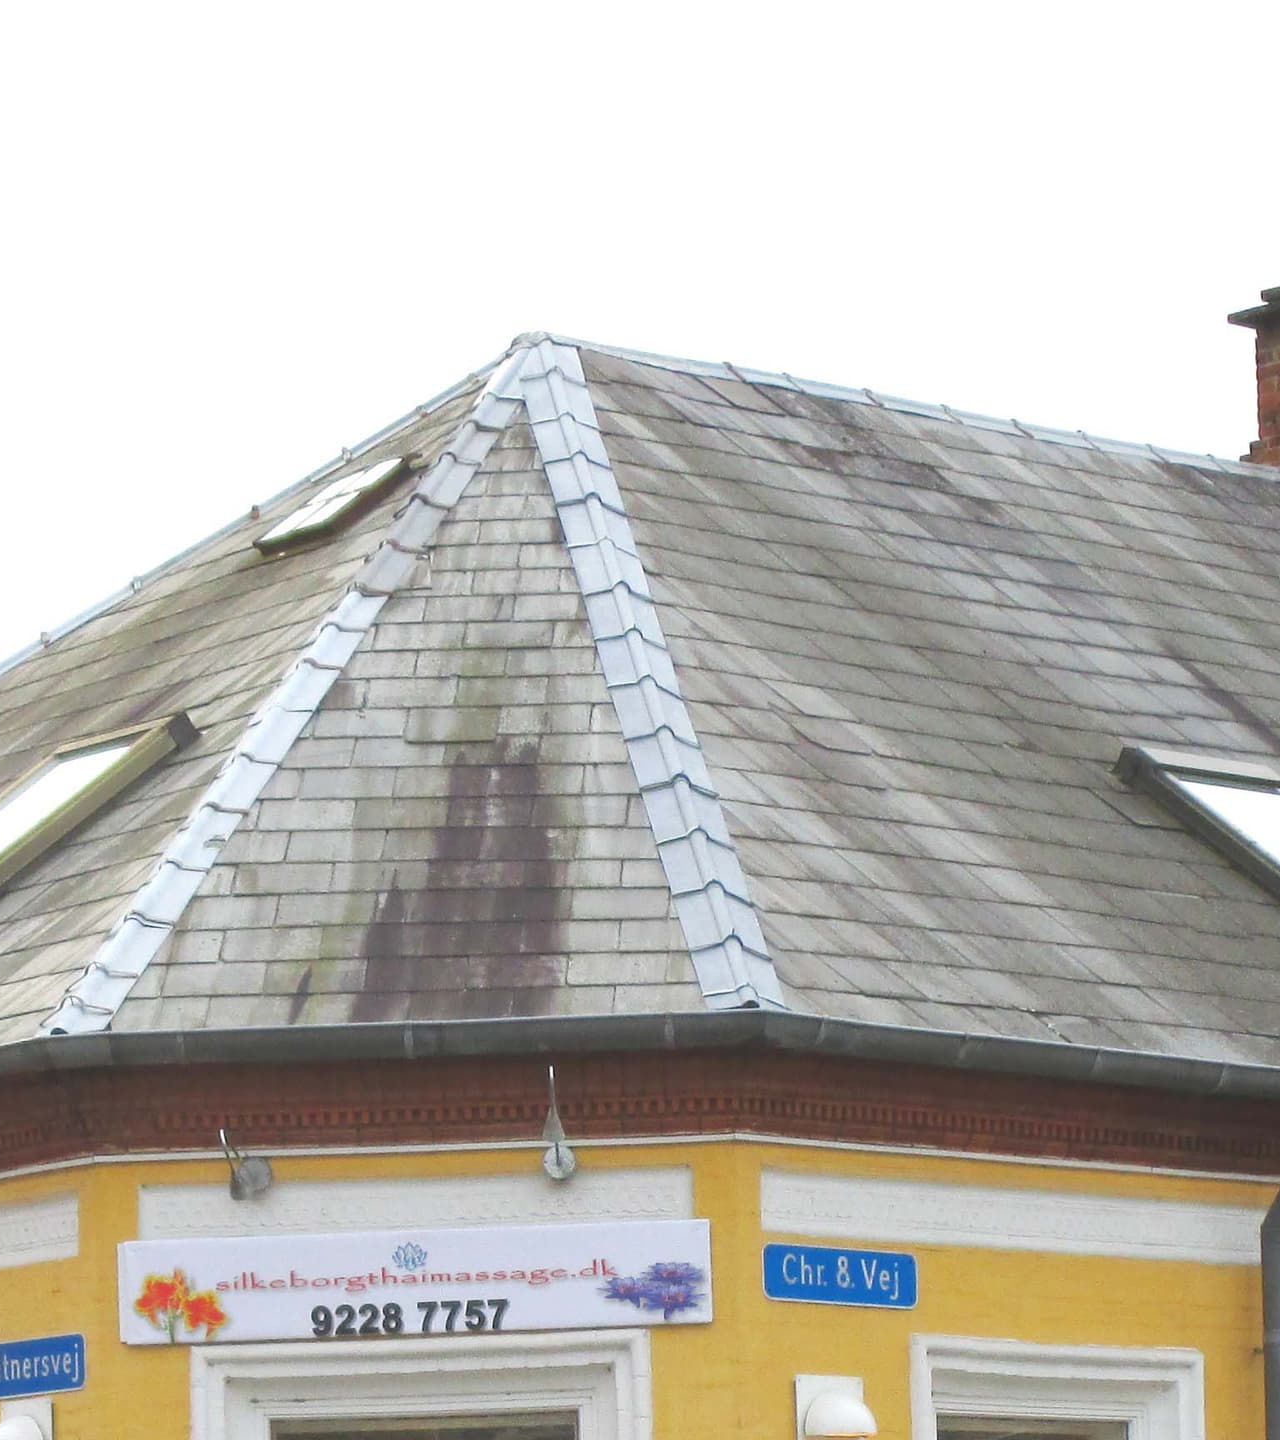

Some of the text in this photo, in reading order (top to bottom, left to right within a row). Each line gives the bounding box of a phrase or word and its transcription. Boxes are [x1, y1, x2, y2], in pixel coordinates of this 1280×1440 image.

[215, 1258, 618, 1294] silkeborgthaimassage.dk
[782, 1253, 900, 1301] Chr. 8. Vej
[310, 1299, 510, 1337] 9228 7757
